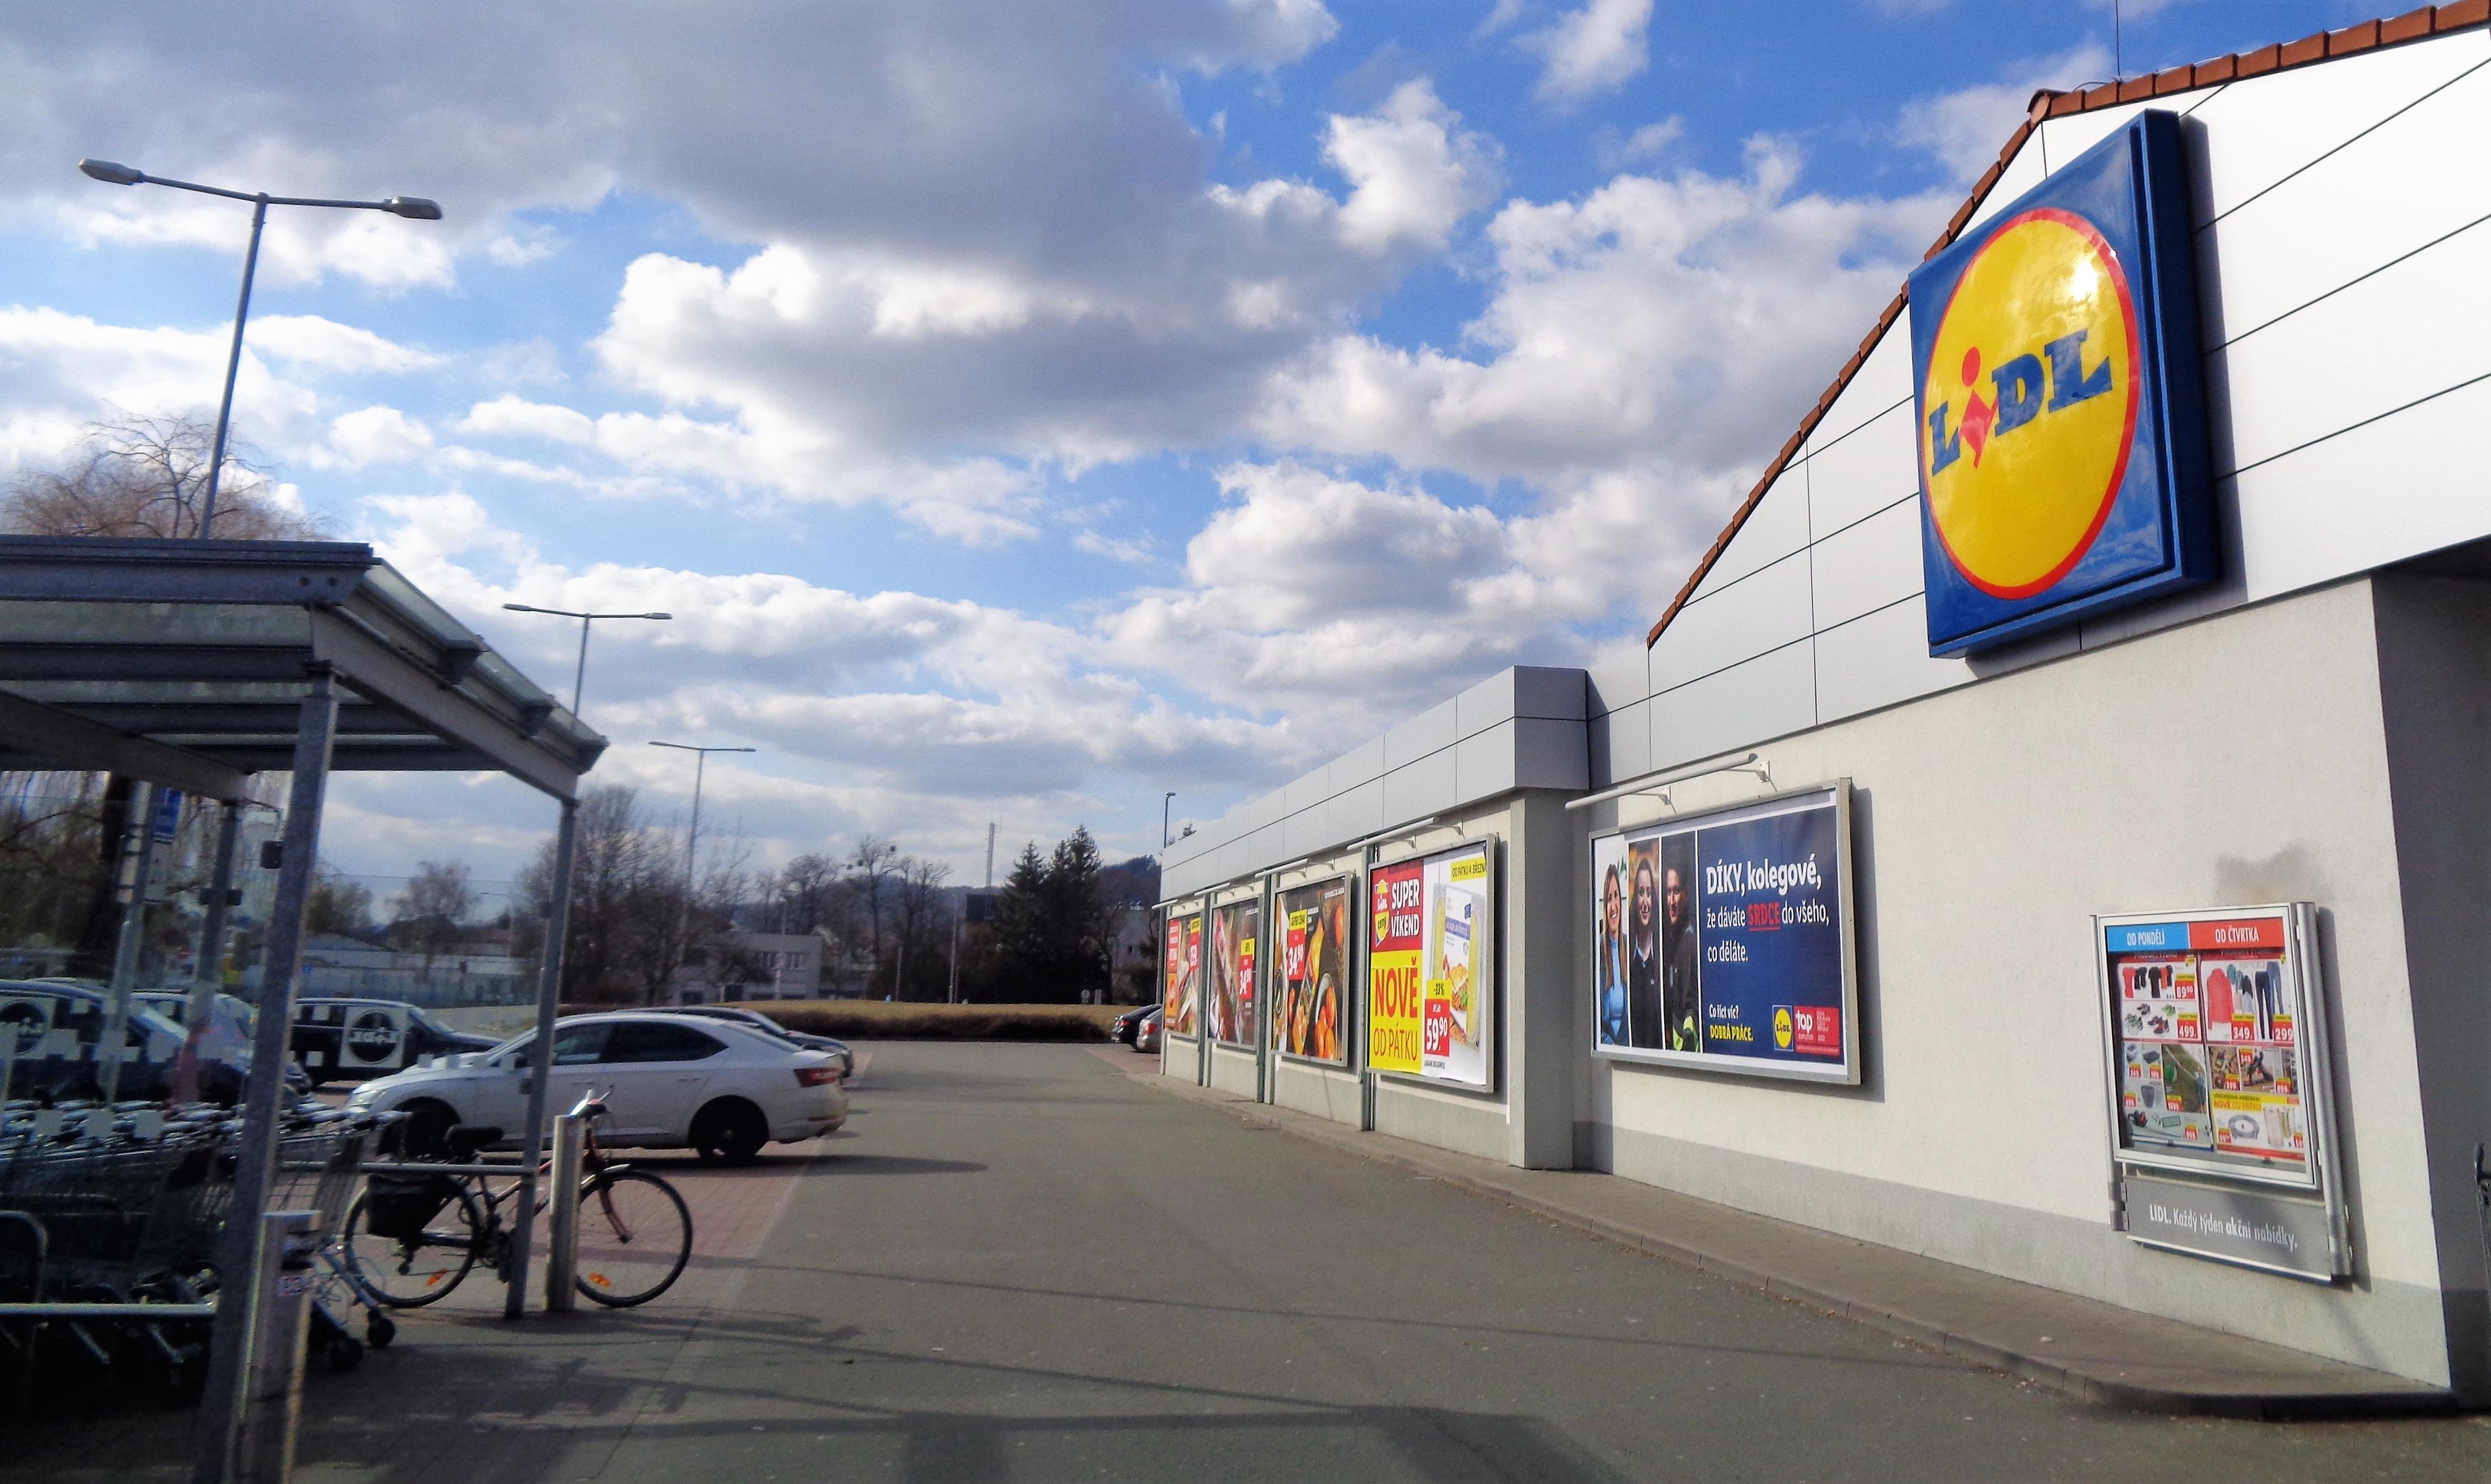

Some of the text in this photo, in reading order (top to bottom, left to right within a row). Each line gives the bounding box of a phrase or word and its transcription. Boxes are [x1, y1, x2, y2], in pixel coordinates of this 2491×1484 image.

[1706, 853, 1822, 897] DÍKY, kolegové,
[1391, 878, 1420, 910] SUPER
[1391, 910, 1420, 937] VÍKEND
[1707, 899, 1830, 929] že dáváte SRDCE do všeho,
[2127, 928, 2165, 946] OD PONDĚLÍ
[2215, 925, 2259, 943] OD ČTVRTKA
[1708, 940, 1748, 962] co děláte.
[1374, 957, 1418, 1018] NOVĚ
[1709, 1004, 1716, 1018] Co
[1728, 1004, 1739, 1019] víc?
[1796, 1009, 1813, 1034] top
[1373, 1022, 1418, 1061] OD PÁTKU
[1709, 1023, 1754, 1041] DOBRÁ PRÁCE.
[2149, 1204, 2298, 1252] LIDL. Každý týden akční nabídky.
